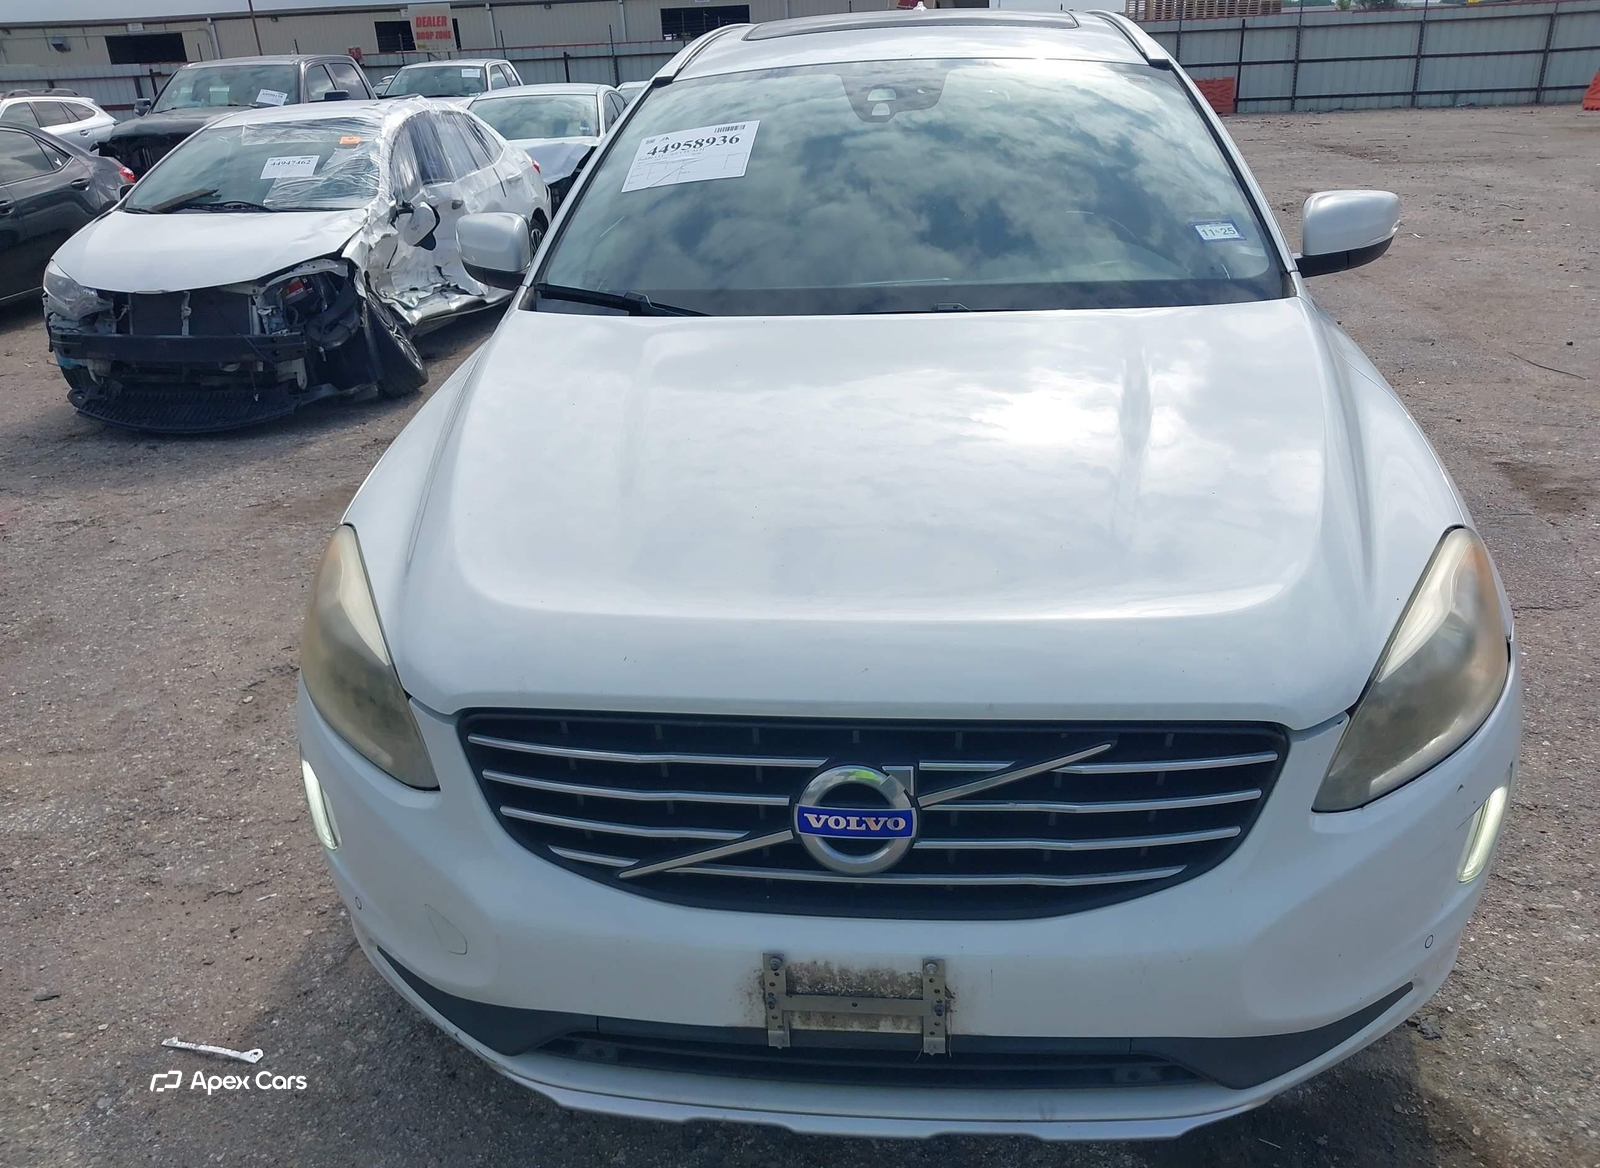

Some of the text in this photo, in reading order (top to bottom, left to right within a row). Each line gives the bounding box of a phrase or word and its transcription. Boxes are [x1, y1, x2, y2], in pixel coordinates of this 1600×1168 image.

[416, 16, 447, 28] DEALER
[435, 31, 452, 39] ZONE
[646, 134, 741, 156] 44958936
[803, 813, 906, 831] VOLVO
